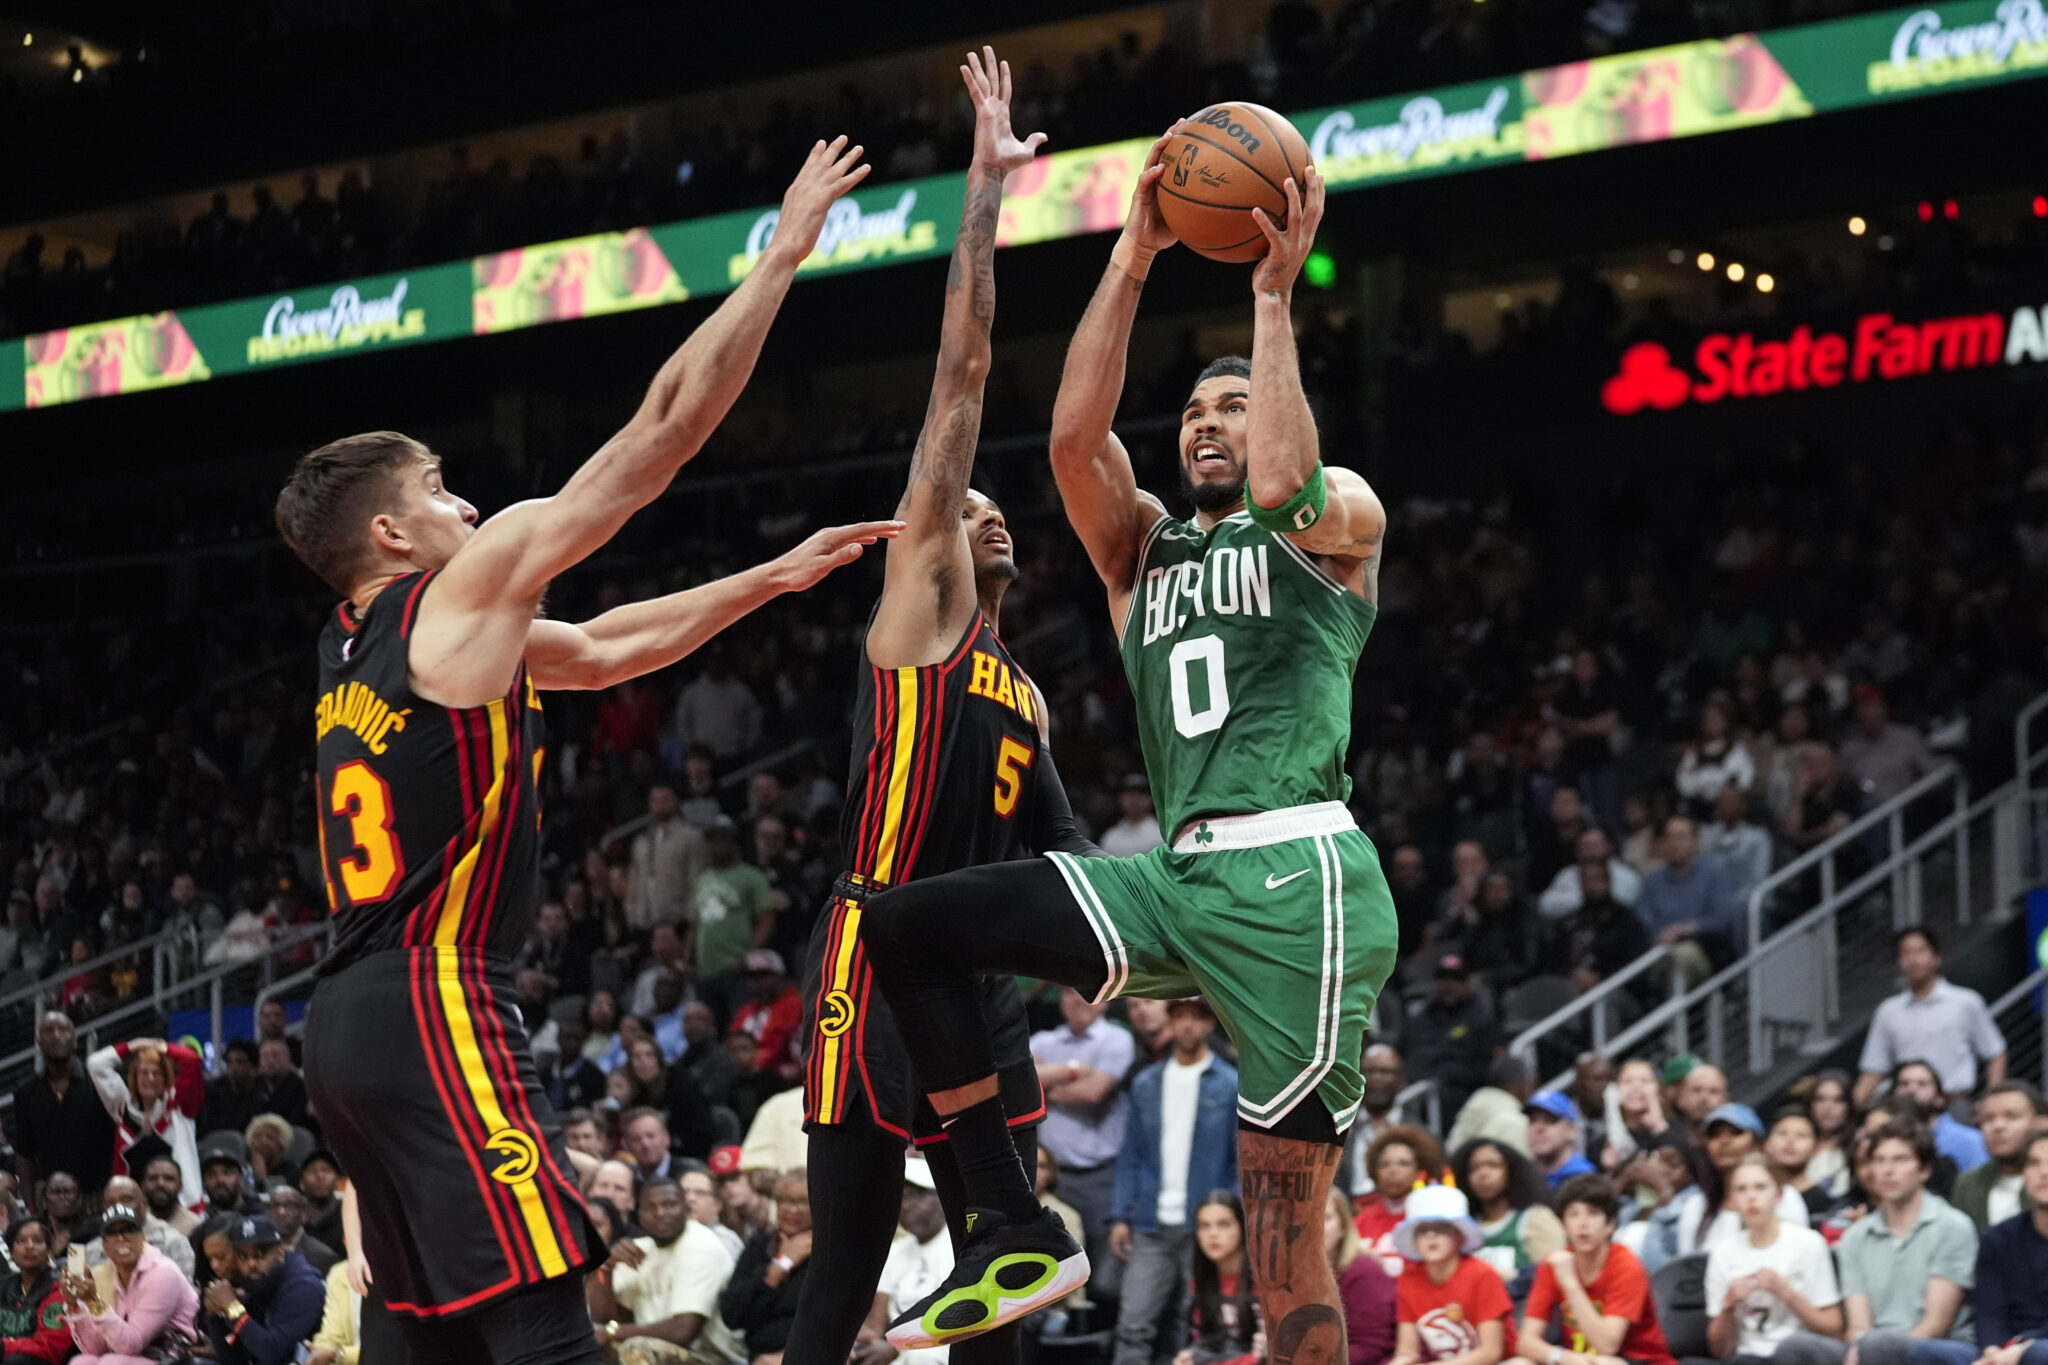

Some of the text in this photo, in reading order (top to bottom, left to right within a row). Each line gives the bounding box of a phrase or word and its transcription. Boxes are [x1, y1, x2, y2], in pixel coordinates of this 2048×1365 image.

[1692, 326, 1848, 403] State
[1850, 312, 2005, 382] Farm
[1169, 633, 1230, 739] 0
[994, 734, 1034, 819] 5
